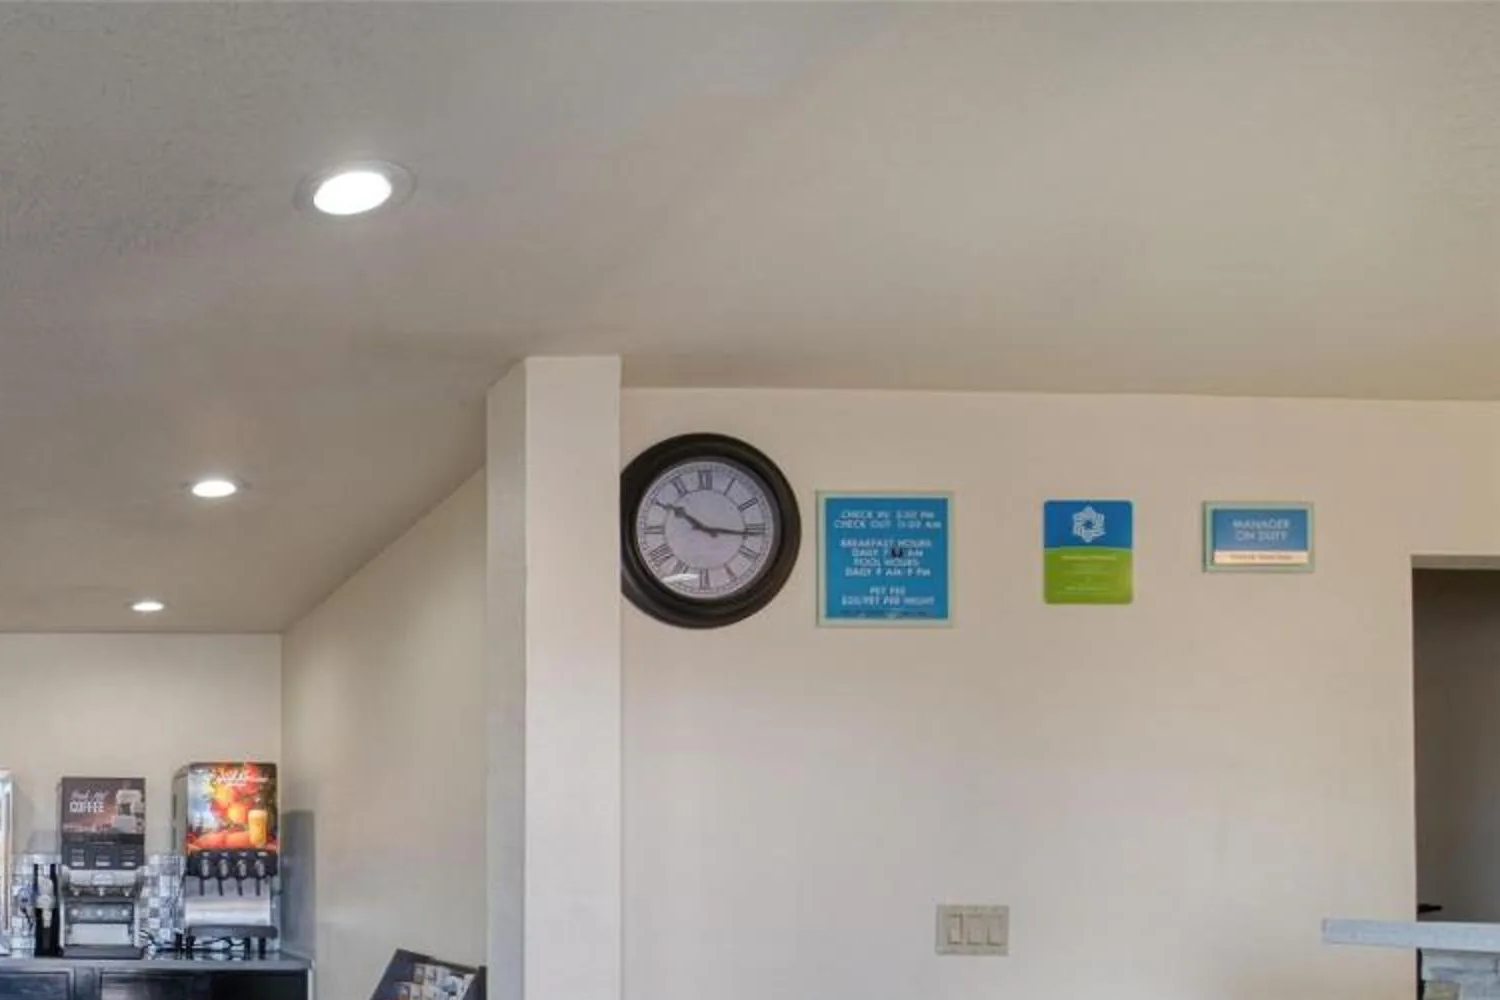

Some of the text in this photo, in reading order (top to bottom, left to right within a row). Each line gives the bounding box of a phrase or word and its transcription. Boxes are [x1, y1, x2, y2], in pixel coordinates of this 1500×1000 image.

[841, 510, 873, 519] CHECK
[834, 519, 866, 529] CHECK
[1231, 517, 1290, 529] MANAGER
[1235, 530, 1288, 541] ON DUTY
[839, 538, 894, 549] BREAKFAST
[852, 547, 879, 557] DAILY
[852, 557, 882, 567] POOL
[845, 567, 872, 577] DAILY
[869, 586, 887, 596] PET
[903, 595, 935, 606] NIGHT
